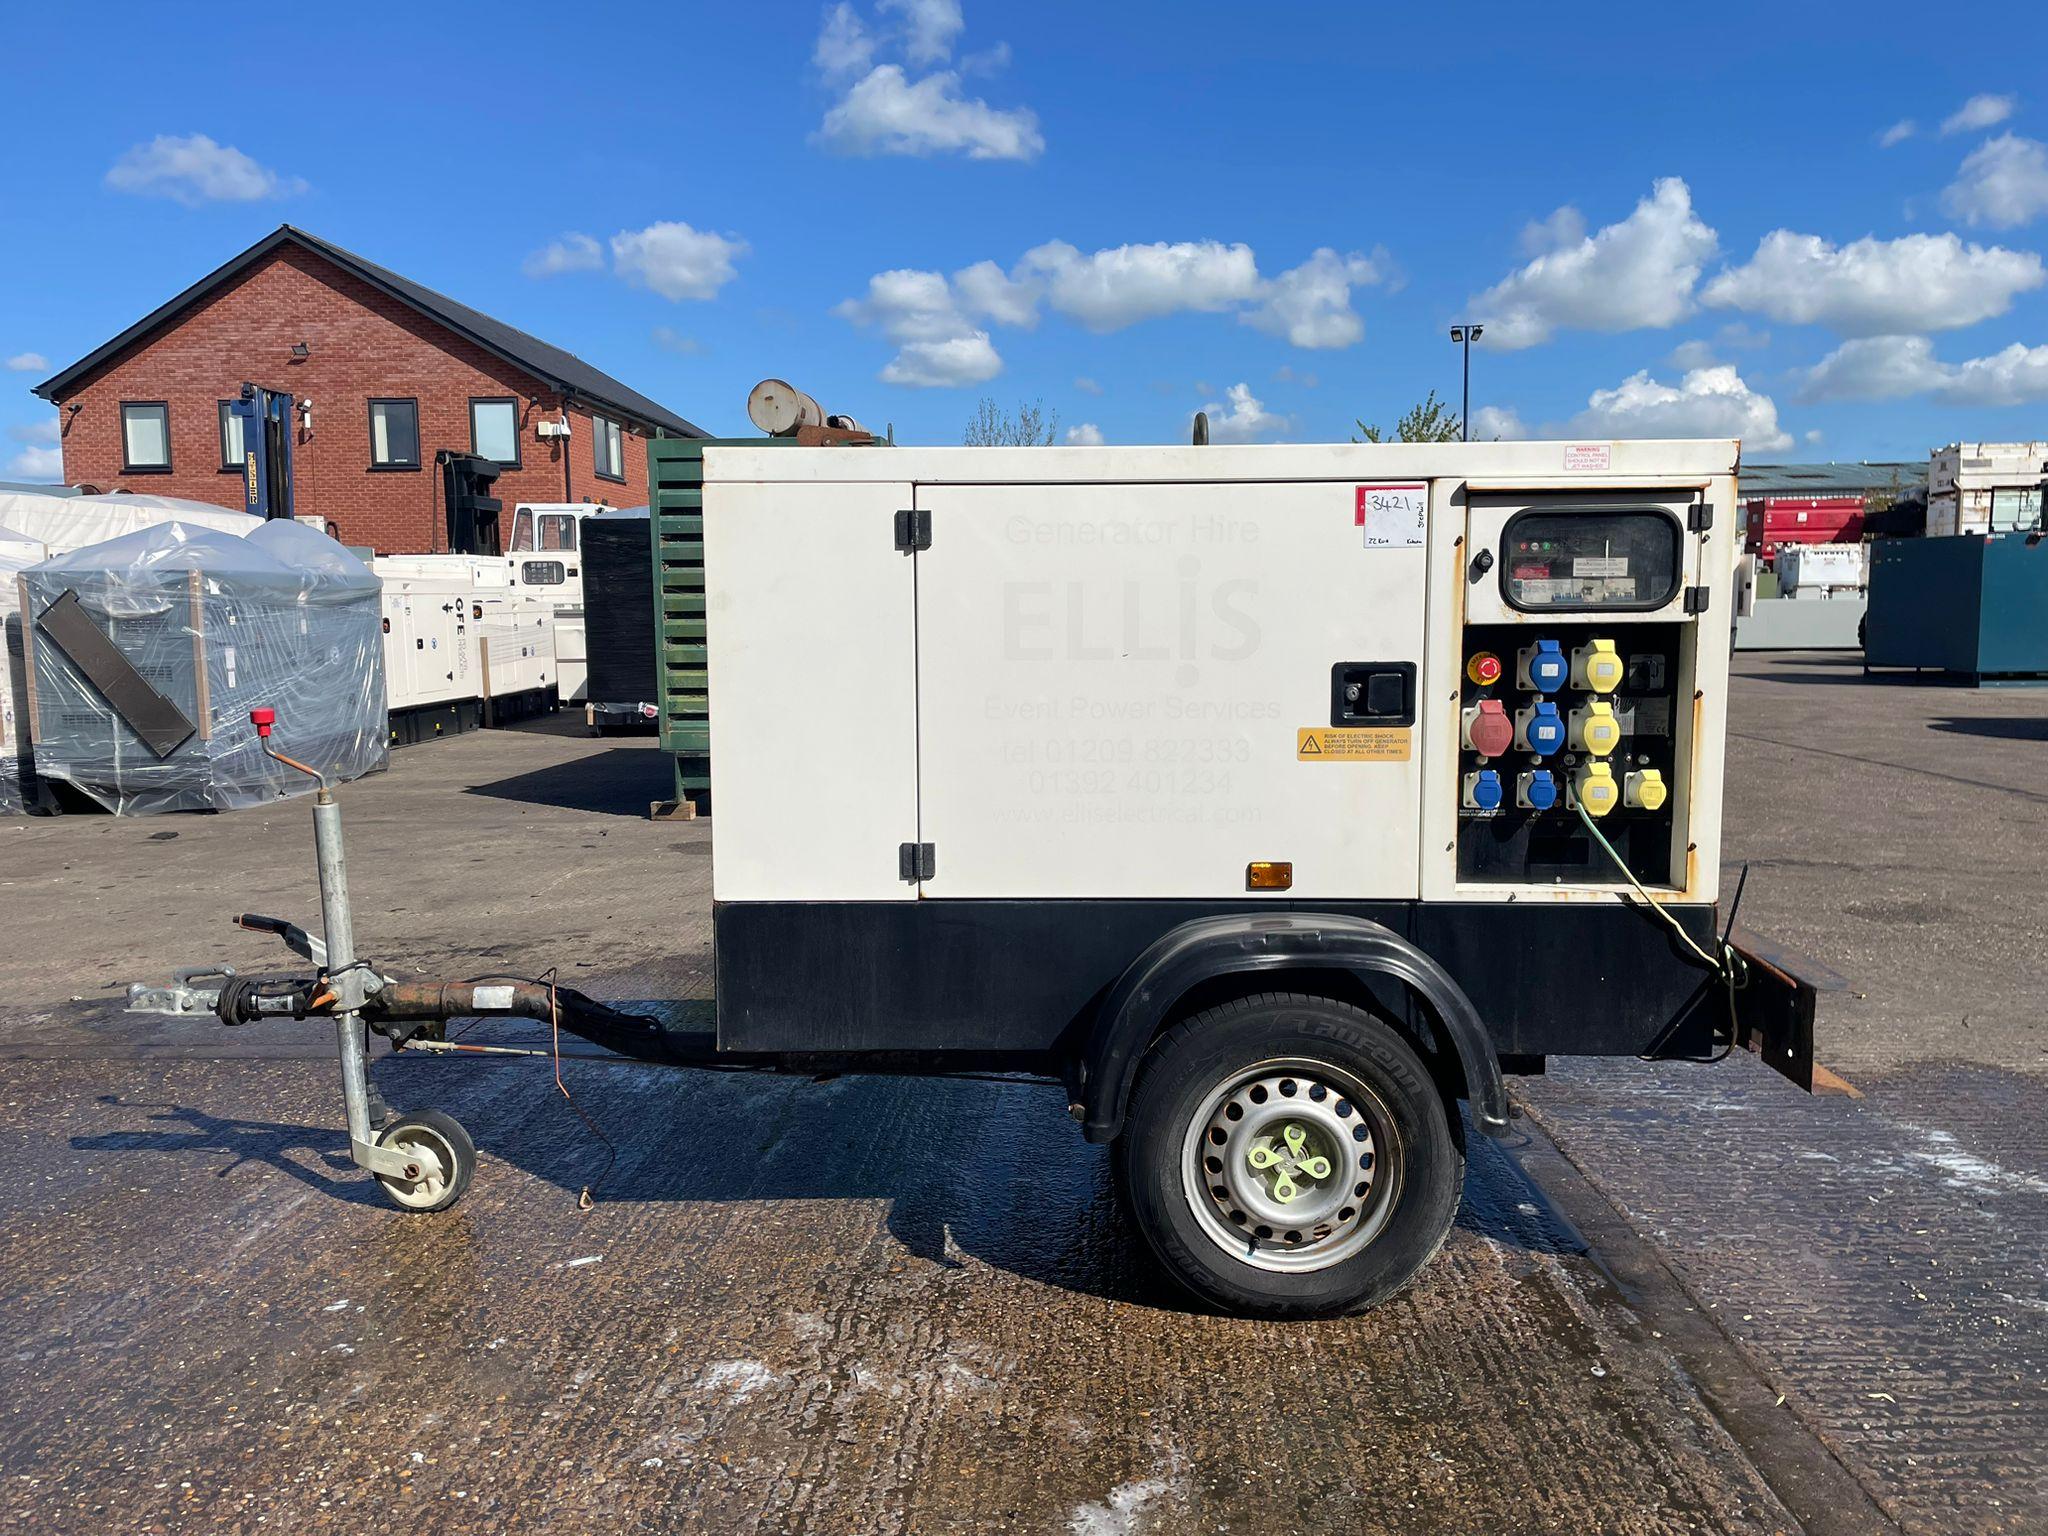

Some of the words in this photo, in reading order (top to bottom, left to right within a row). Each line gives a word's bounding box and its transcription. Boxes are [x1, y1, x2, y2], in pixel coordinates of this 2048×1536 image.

[1371, 495, 1410, 512] 3421
[1004, 514, 1178, 545] Generator
[1191, 512, 1261, 543] Hire
[455, 597, 465, 635] GFE
[984, 694, 1059, 720] Event
[1069, 696, 1156, 720] Power
[1165, 696, 1281, 720] Services
[1002, 738, 1035, 764] tel
[1045, 737, 1133, 764] 01209
[1144, 738, 1251, 763] 822333
[1028, 770, 1116, 795] 01392
[1126, 770, 1233, 795] 401234
[992, 802, 1263, 825] www.elliselectrical.com
